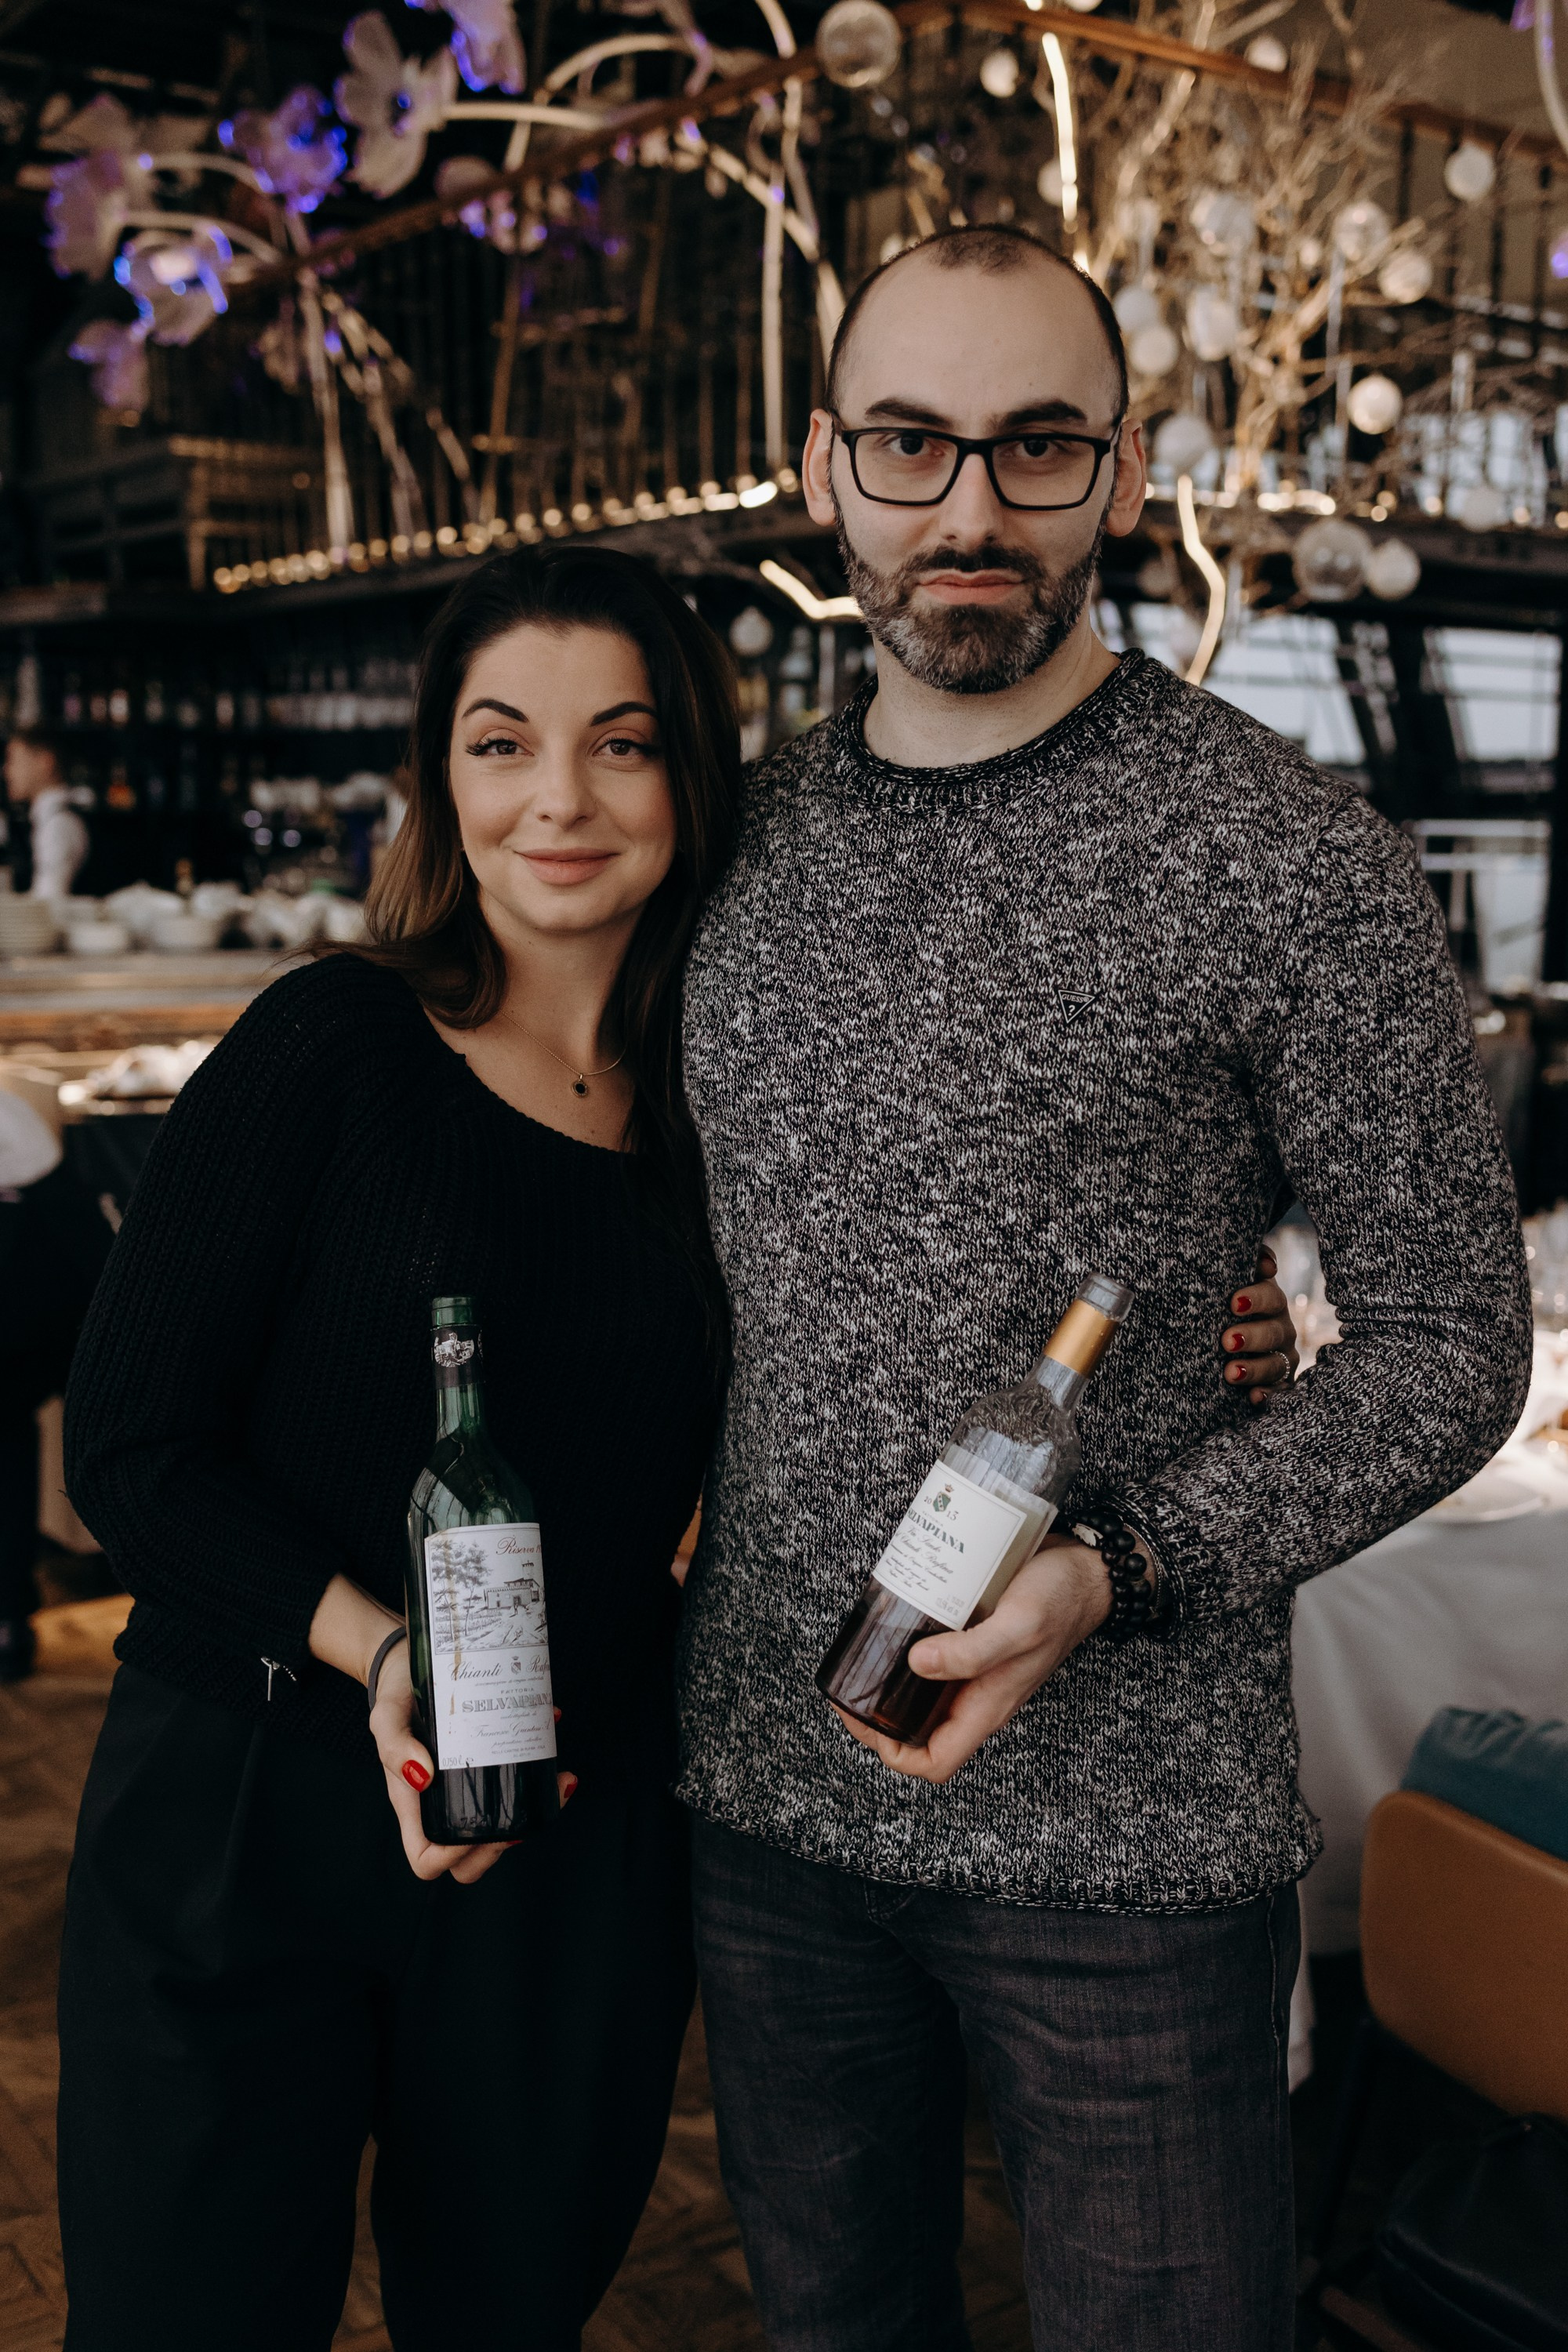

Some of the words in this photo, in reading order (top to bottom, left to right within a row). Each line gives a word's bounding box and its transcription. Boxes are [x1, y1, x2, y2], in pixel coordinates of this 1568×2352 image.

[923, 1495, 932, 1505] 20
[495, 1534, 535, 1555] Riserva
[449, 1661, 503, 1682] Chianti
